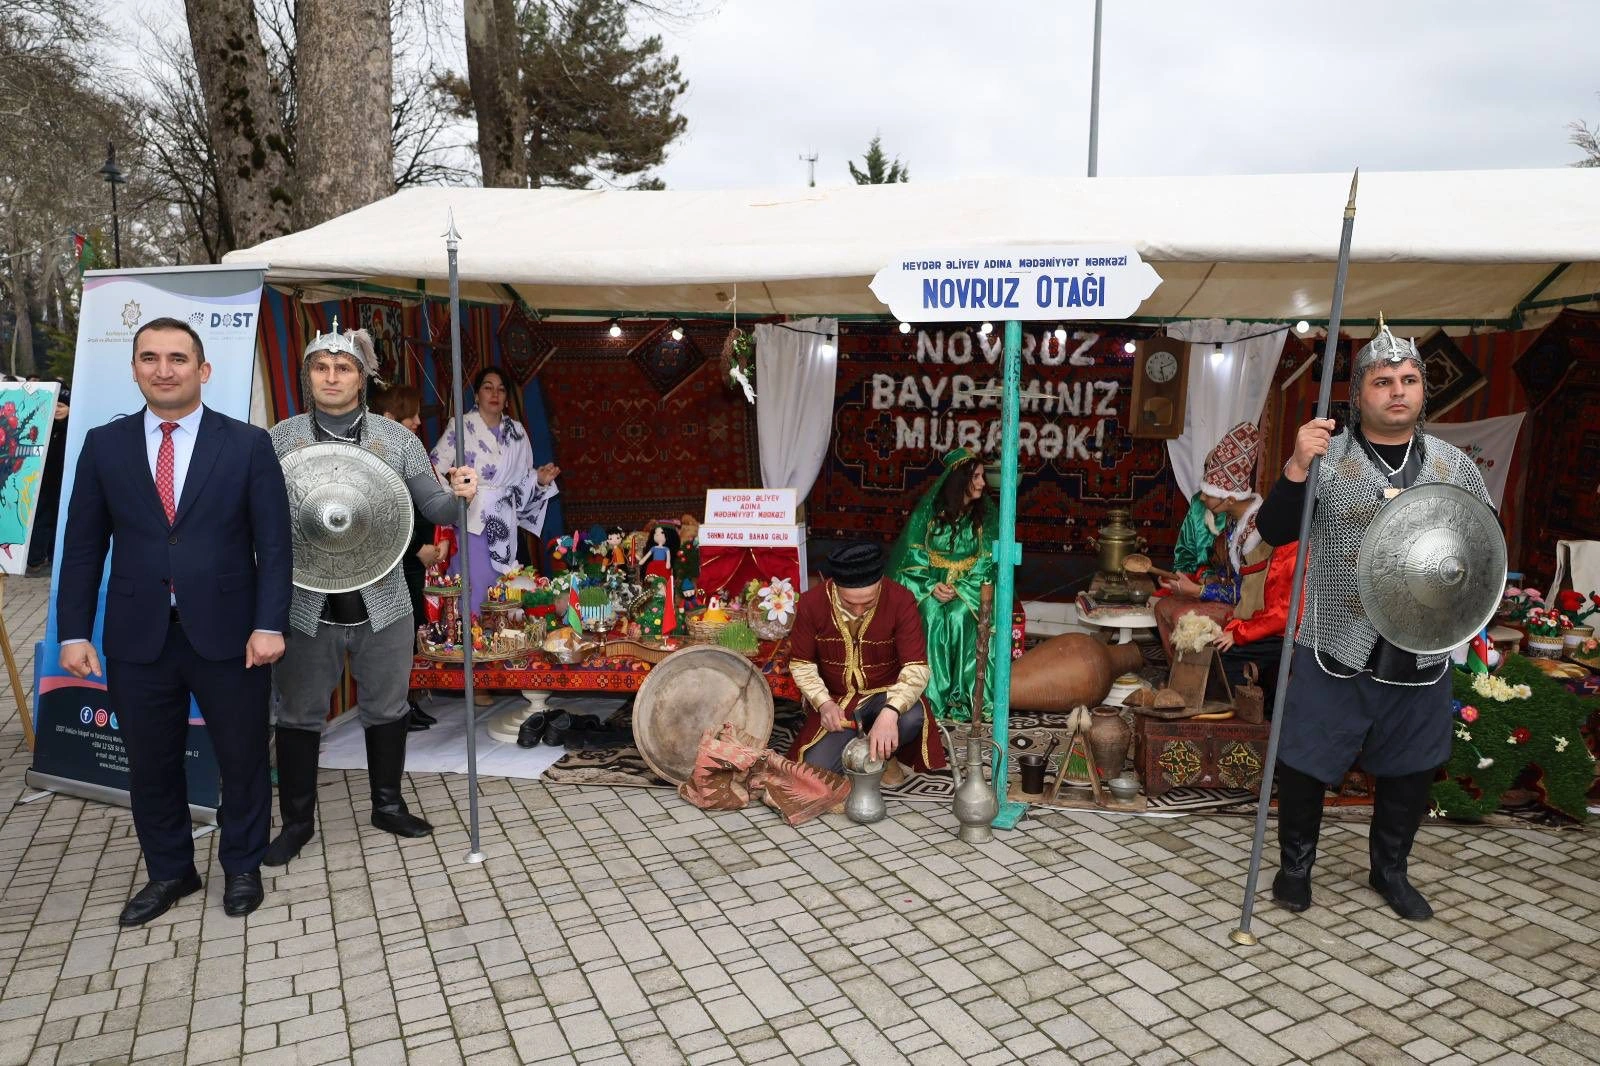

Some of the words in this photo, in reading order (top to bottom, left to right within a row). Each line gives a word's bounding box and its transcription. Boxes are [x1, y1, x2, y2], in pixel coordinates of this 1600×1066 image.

[902, 260, 942, 271] HEYDƏR
[945, 259, 980, 270] ƏLİYEV
[983, 258, 1013, 269] ADINA
[1018, 257, 1080, 268] MƏDƏNİYYƏT
[1085, 255, 1128, 267] MƏRKƏZİ
[922, 277, 1020, 309] NOVRUZ
[1036, 272, 1105, 308] OTAĞI
